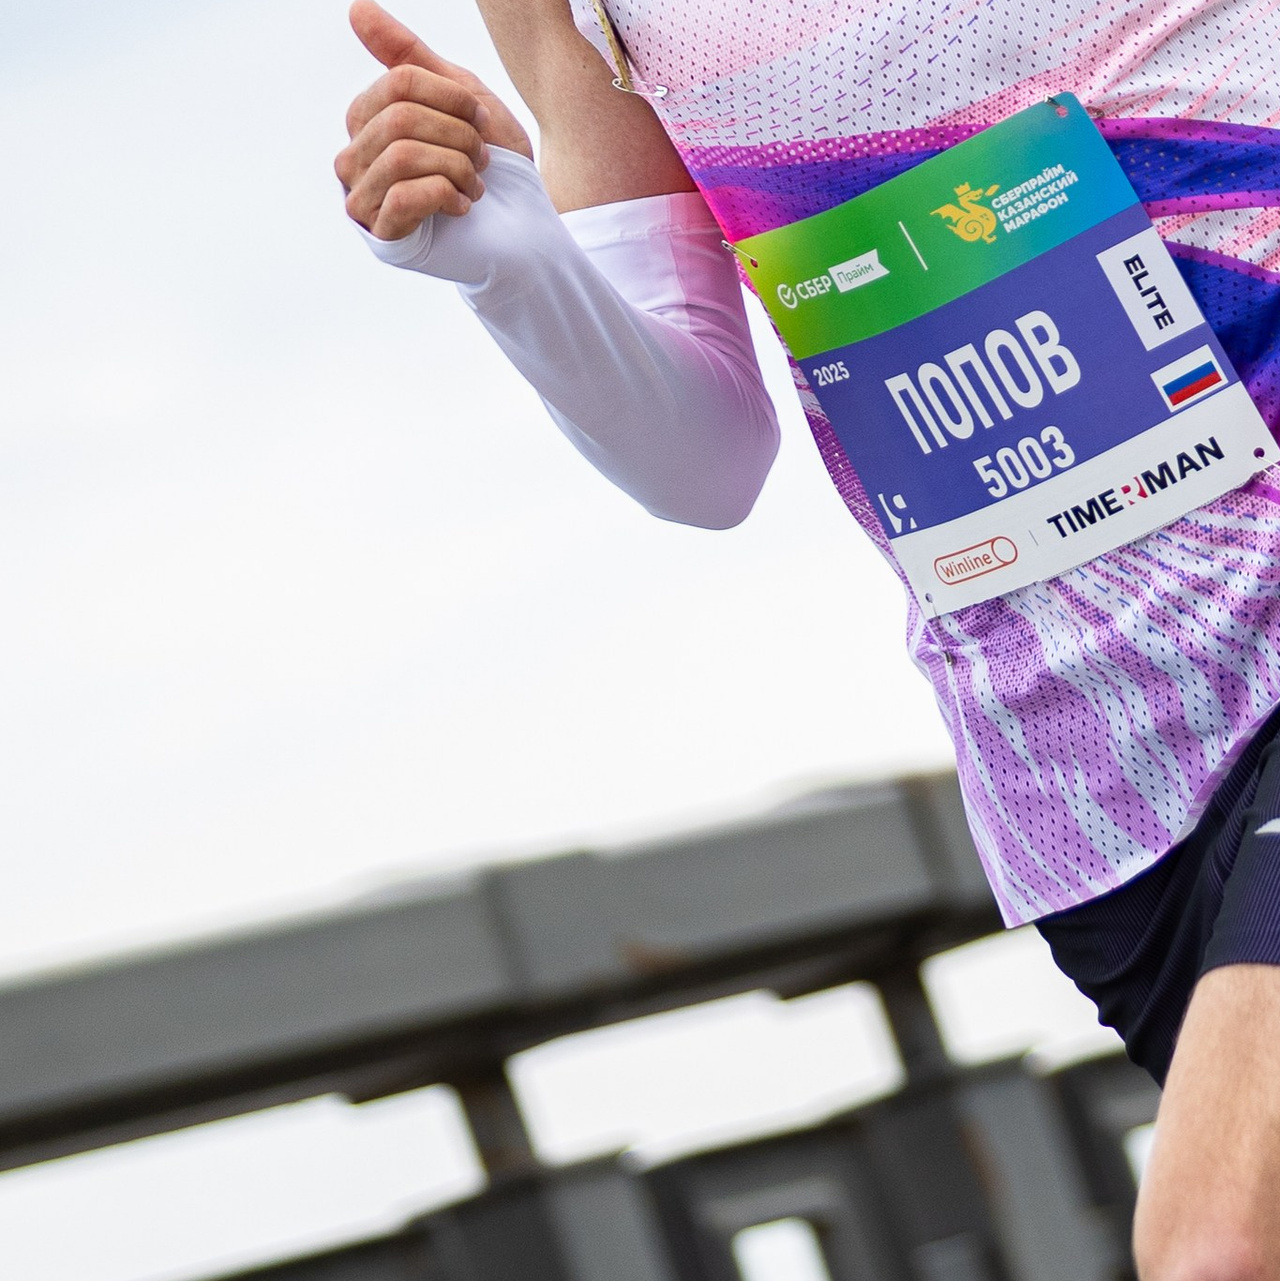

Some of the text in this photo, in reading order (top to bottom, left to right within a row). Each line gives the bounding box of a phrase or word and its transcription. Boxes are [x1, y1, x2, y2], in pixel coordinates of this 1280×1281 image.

[991, 163, 1065, 209] СБЕРПРАЙМ
[997, 170, 1079, 221] КАЗАНСКИЙ
[1003, 192, 1069, 233] МАРАФОН
[796, 263, 874, 299] СБЕР Прайм
[1123, 253, 1175, 330] ELITE
[812, 361, 850, 387] 2025
[884, 310, 1081, 455] ПОПОВ
[972, 426, 1075, 498] 5003
[939, 552, 993, 578] Winline
